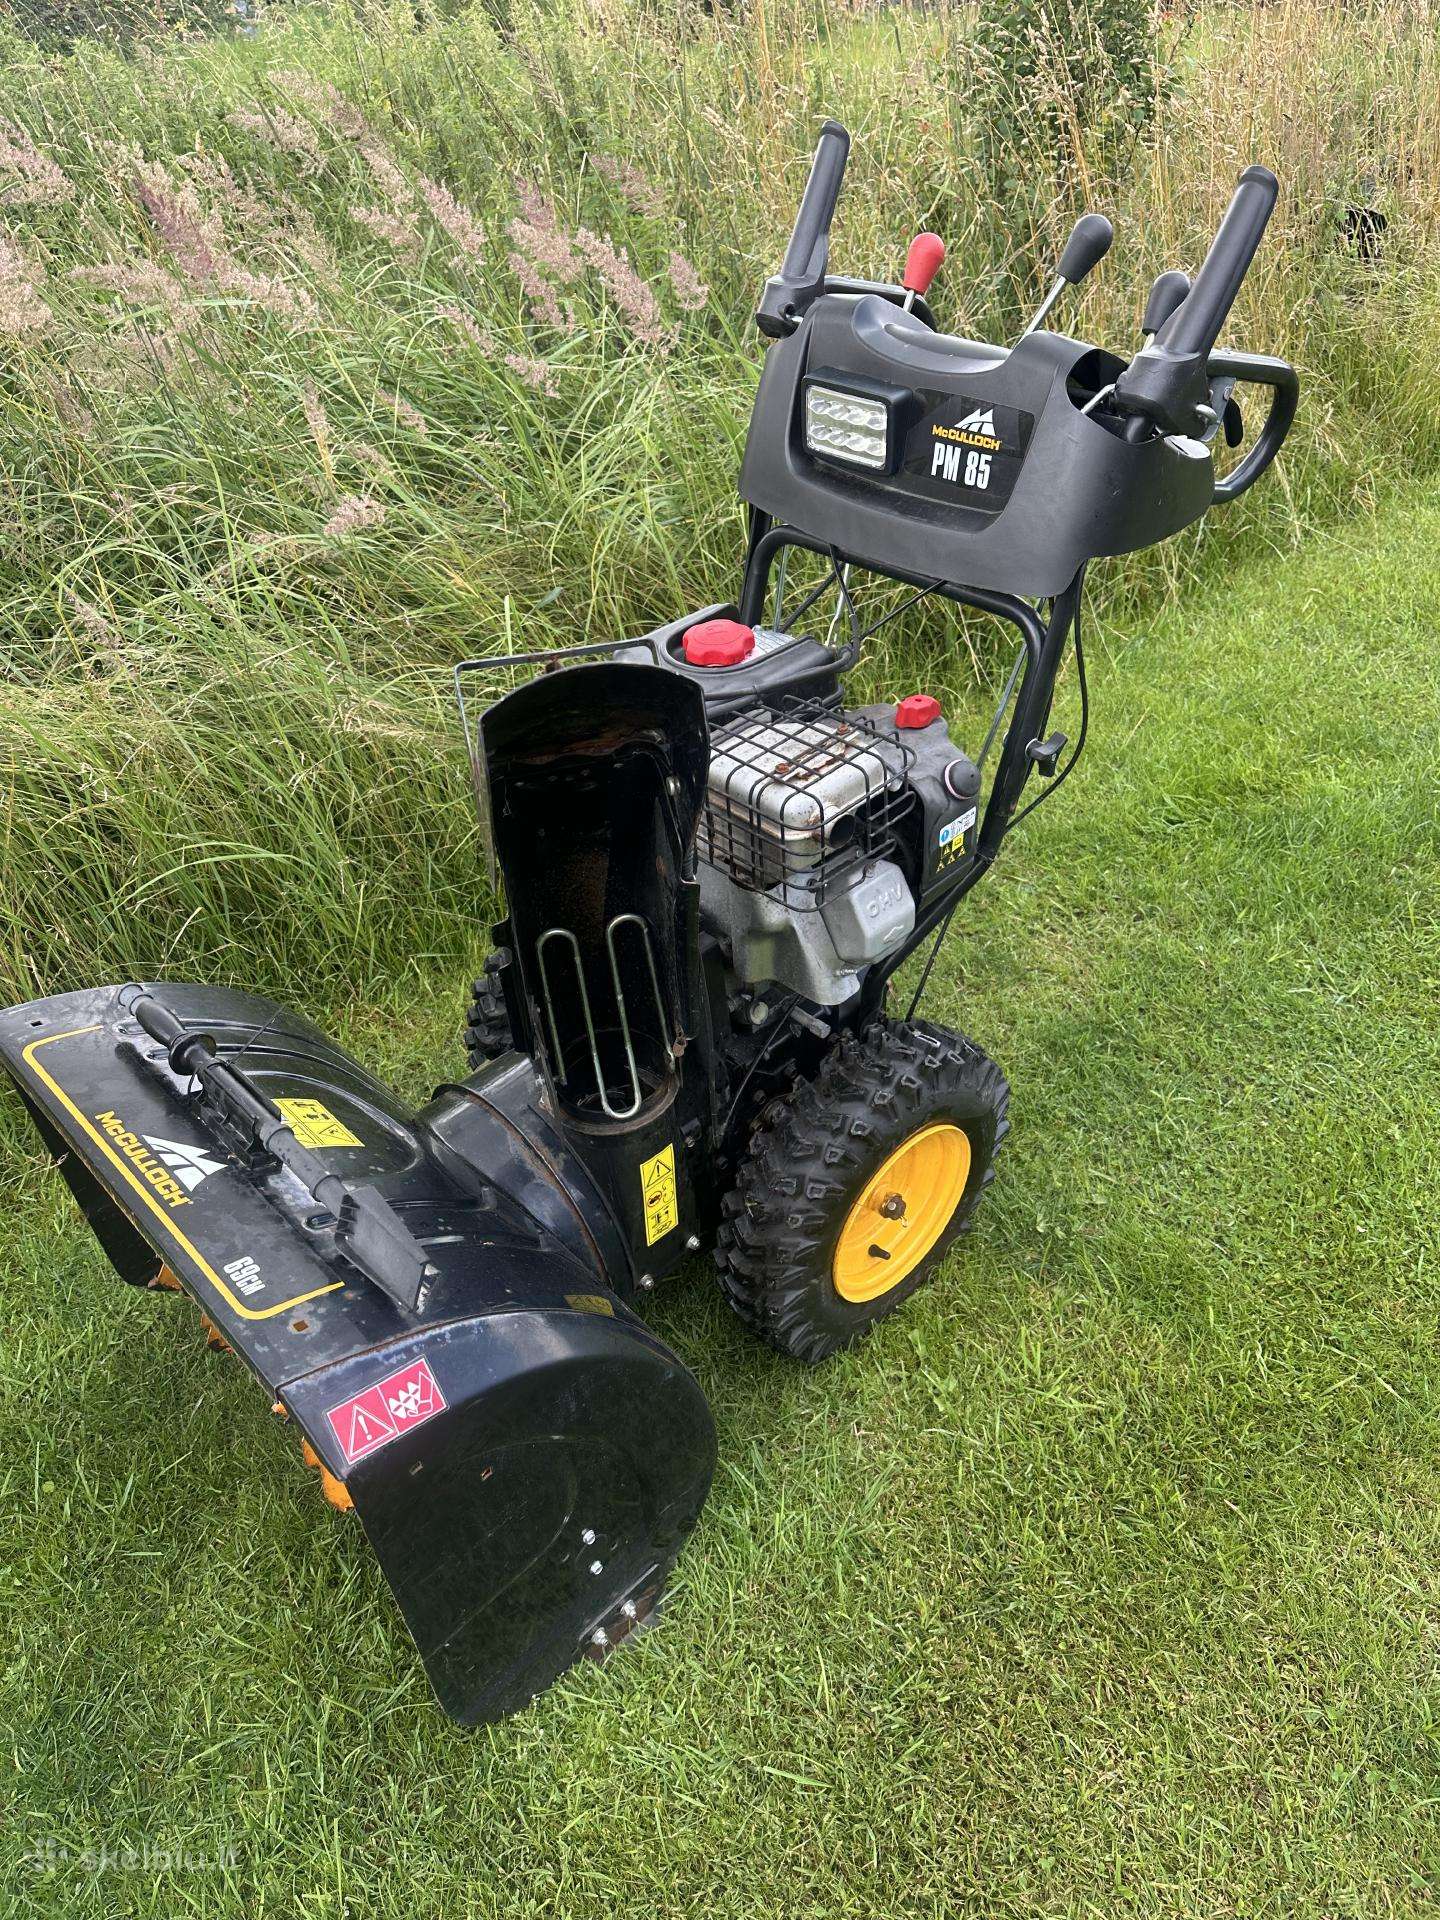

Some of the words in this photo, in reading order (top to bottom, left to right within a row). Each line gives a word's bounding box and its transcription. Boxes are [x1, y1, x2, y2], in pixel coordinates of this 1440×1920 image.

[932, 424, 1002, 451] McCULLOCH
[931, 442, 961, 482] PM
[965, 451, 992, 489] 85
[95, 1110, 193, 1208] McCULLOCH
